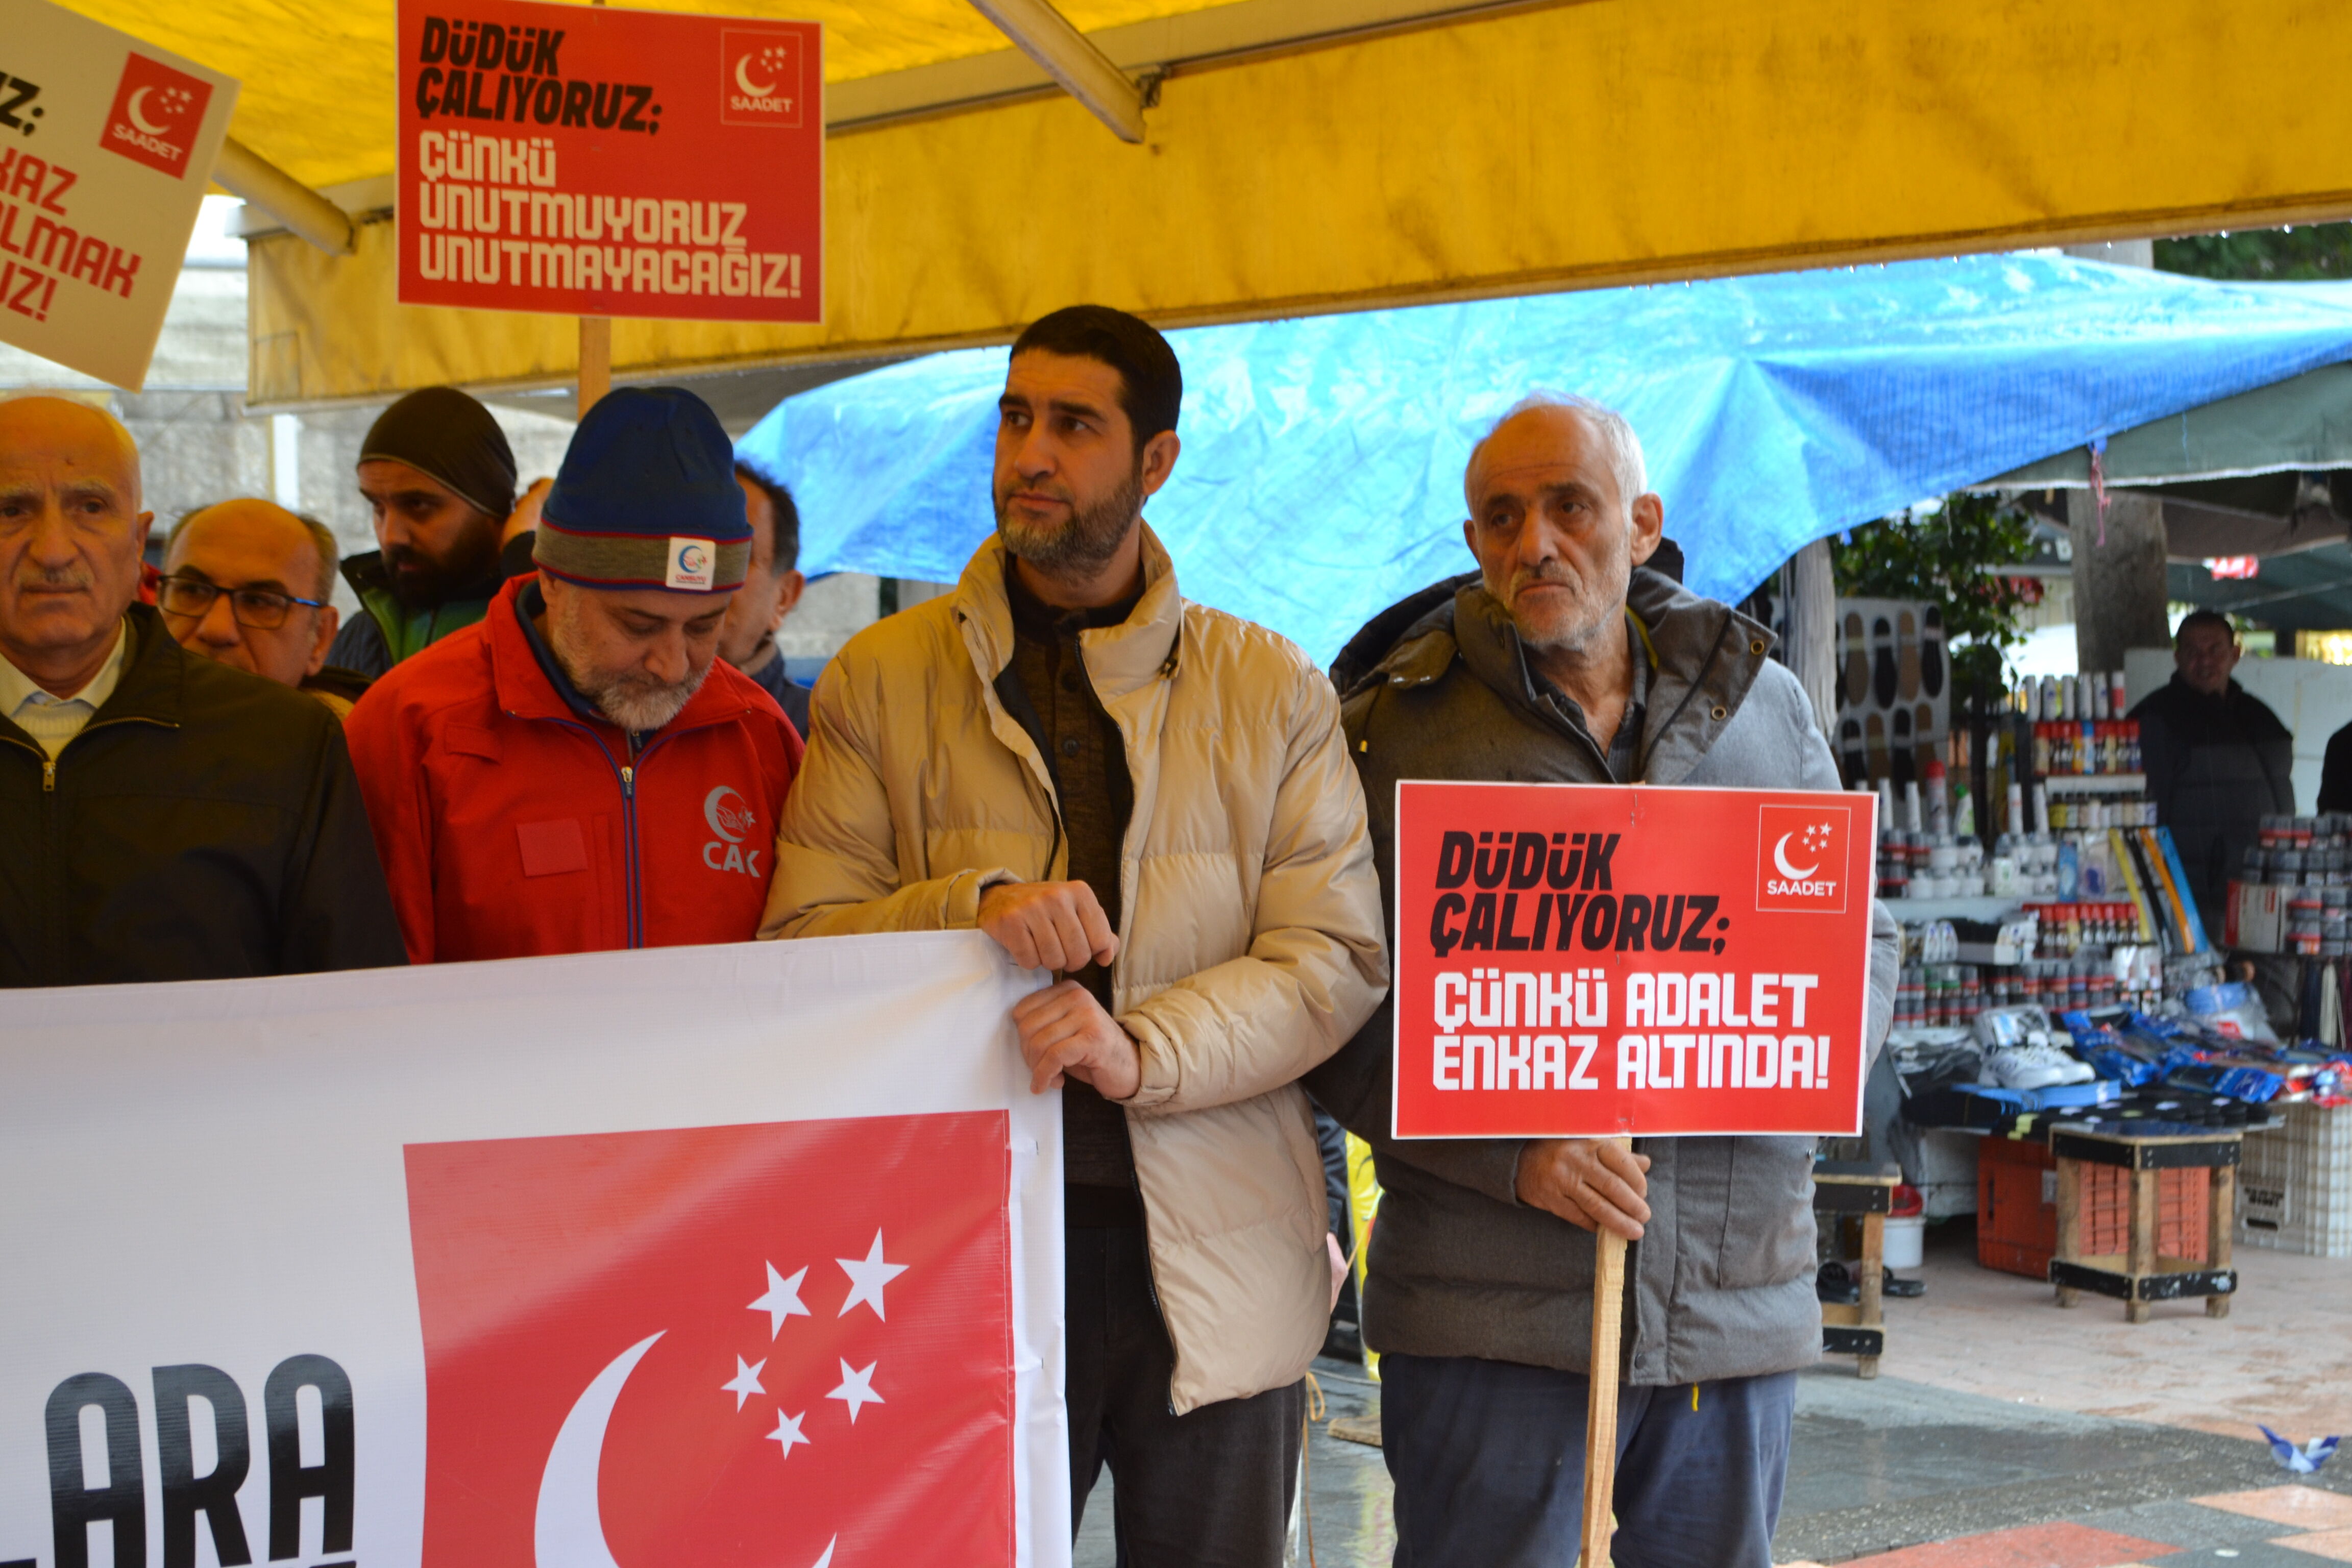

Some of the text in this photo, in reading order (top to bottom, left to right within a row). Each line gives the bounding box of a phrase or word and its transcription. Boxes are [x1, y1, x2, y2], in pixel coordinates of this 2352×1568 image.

[419, 16, 566, 77] DÜDÜK
[0, 70, 45, 136] Z;
[415, 67, 663, 136] ÇALIYORUZ;
[730, 95, 793, 113] SAADET
[112, 123, 184, 162] SAADET
[420, 130, 557, 187] ÇÜNKÜ
[420, 181, 748, 248] UNUTMUYORUZ
[420, 233, 802, 299] UNUTMAYACAĞIZ!
[1434, 831, 1622, 891] DÜDÜK
[1767, 879, 1837, 897] SAADET
[1429, 893, 1730, 958] ÇALIYORUZ;
[1434, 968, 1820, 1033] ÇÜNKÜ ADALET
[1433, 1034, 1831, 1091] ENKAZ ALTINDA!
[0, 1354, 355, 1568] ARA
